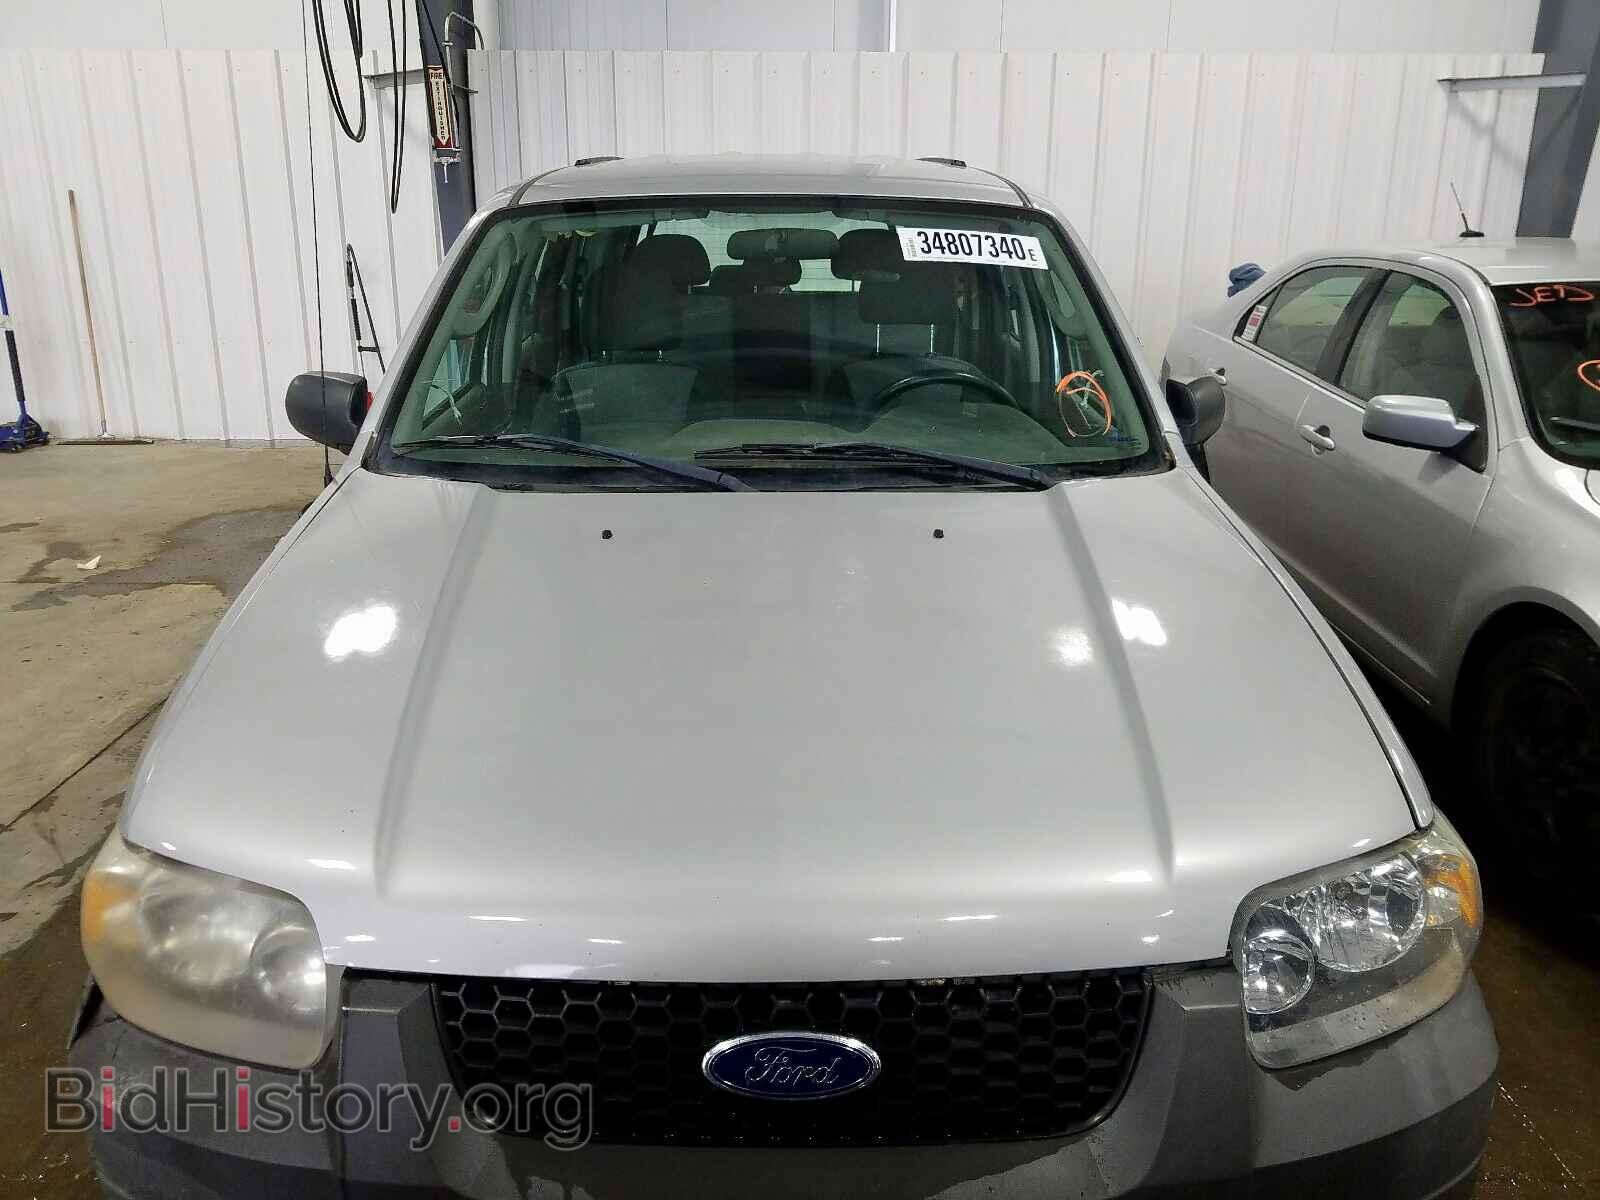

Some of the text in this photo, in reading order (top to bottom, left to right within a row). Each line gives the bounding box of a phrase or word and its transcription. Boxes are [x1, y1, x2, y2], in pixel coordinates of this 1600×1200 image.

[430, 72, 443, 80] FIRE
[916, 231, 1026, 261] 34807340
[1028, 248, 1040, 262] E
[744, 1046, 842, 1087] Ford
